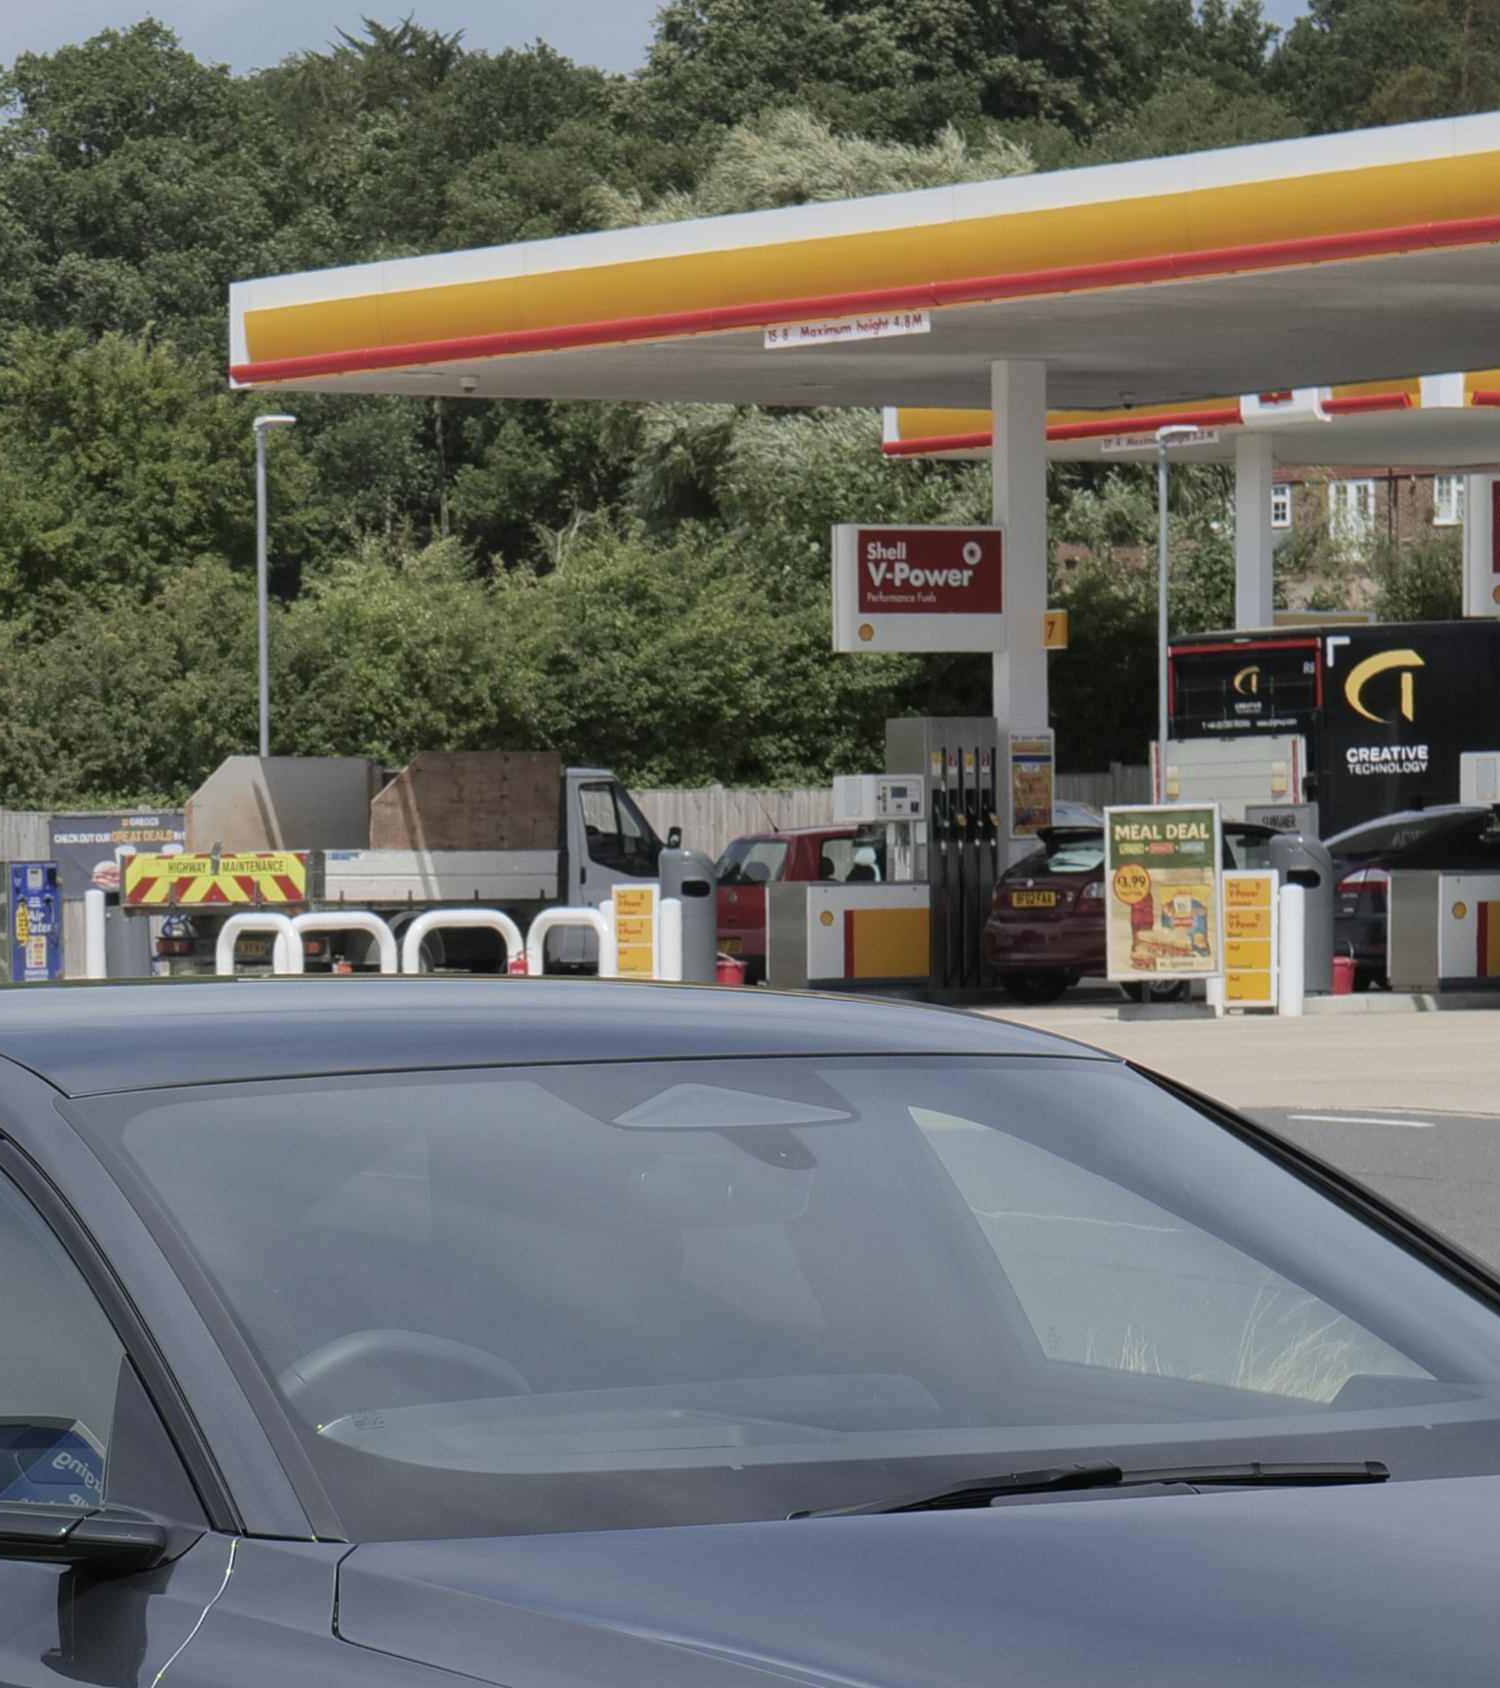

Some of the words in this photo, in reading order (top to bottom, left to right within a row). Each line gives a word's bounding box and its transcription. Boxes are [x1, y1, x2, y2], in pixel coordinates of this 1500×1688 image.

[800, 323, 852, 339] Maximum
[856, 319, 889, 335] height
[866, 541, 907, 560] Shell
[866, 562, 974, 587] V-Power
[866, 592, 915, 603] Performance
[917, 592, 937, 603] Fuels
[1047, 620, 1056, 639] 7
[1346, 744, 1429, 763] CREATIVE
[1347, 762, 1428, 775] TECHNOLOGY
[129, 817, 159, 827] GREGGS
[54, 833, 80, 844] CHECK
[111, 830, 142, 842] GREAT
[143, 829, 173, 842] DEALS
[1114, 825, 1162, 841] MEAL
[1166, 823, 1210, 841] DEAL
[167, 862, 208, 874] HIGHWAY
[221, 860, 285, 873] MAINTENANCE
[1228, 890, 1258, 898] V-Power
[29, 908, 45, 920] Air
[1228, 921, 1258, 929] V-Power
